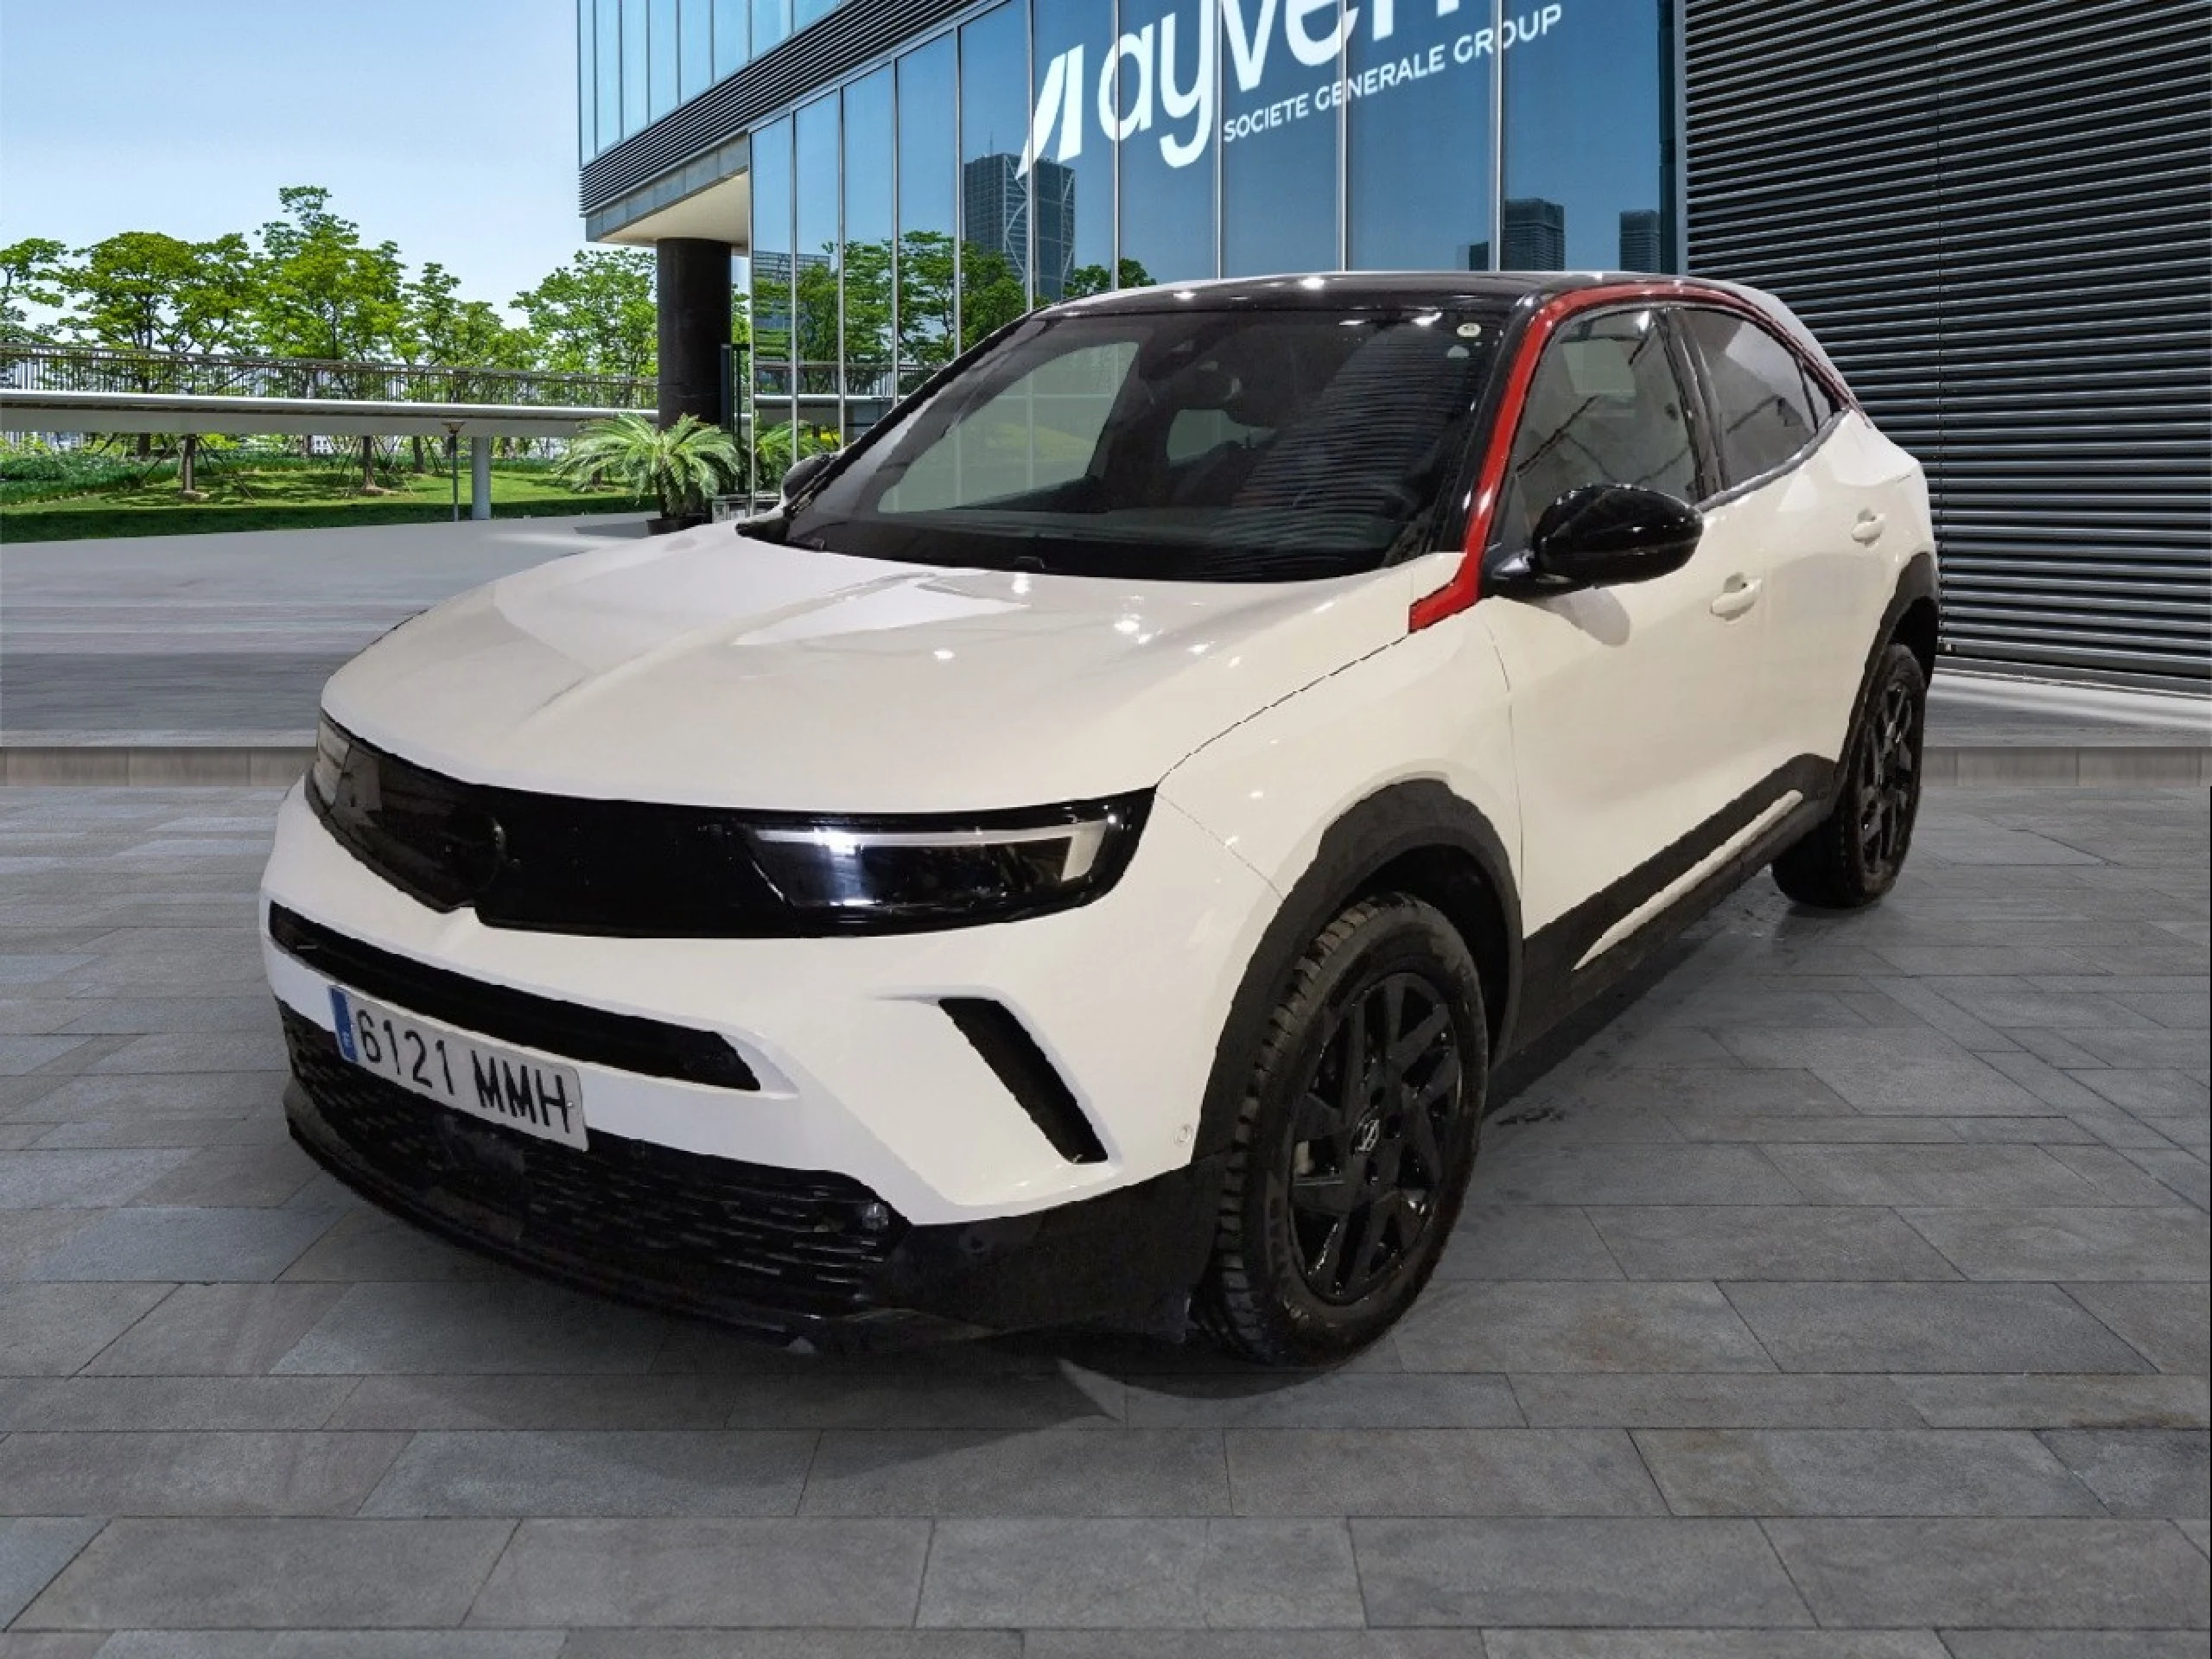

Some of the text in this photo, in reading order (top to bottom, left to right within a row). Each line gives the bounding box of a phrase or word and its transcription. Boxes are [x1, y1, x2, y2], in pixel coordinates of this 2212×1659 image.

[1224, 3, 1562, 143] SOCIETE GENERALE GROUP
[357, 1008, 571, 1135] 6121 MMH
